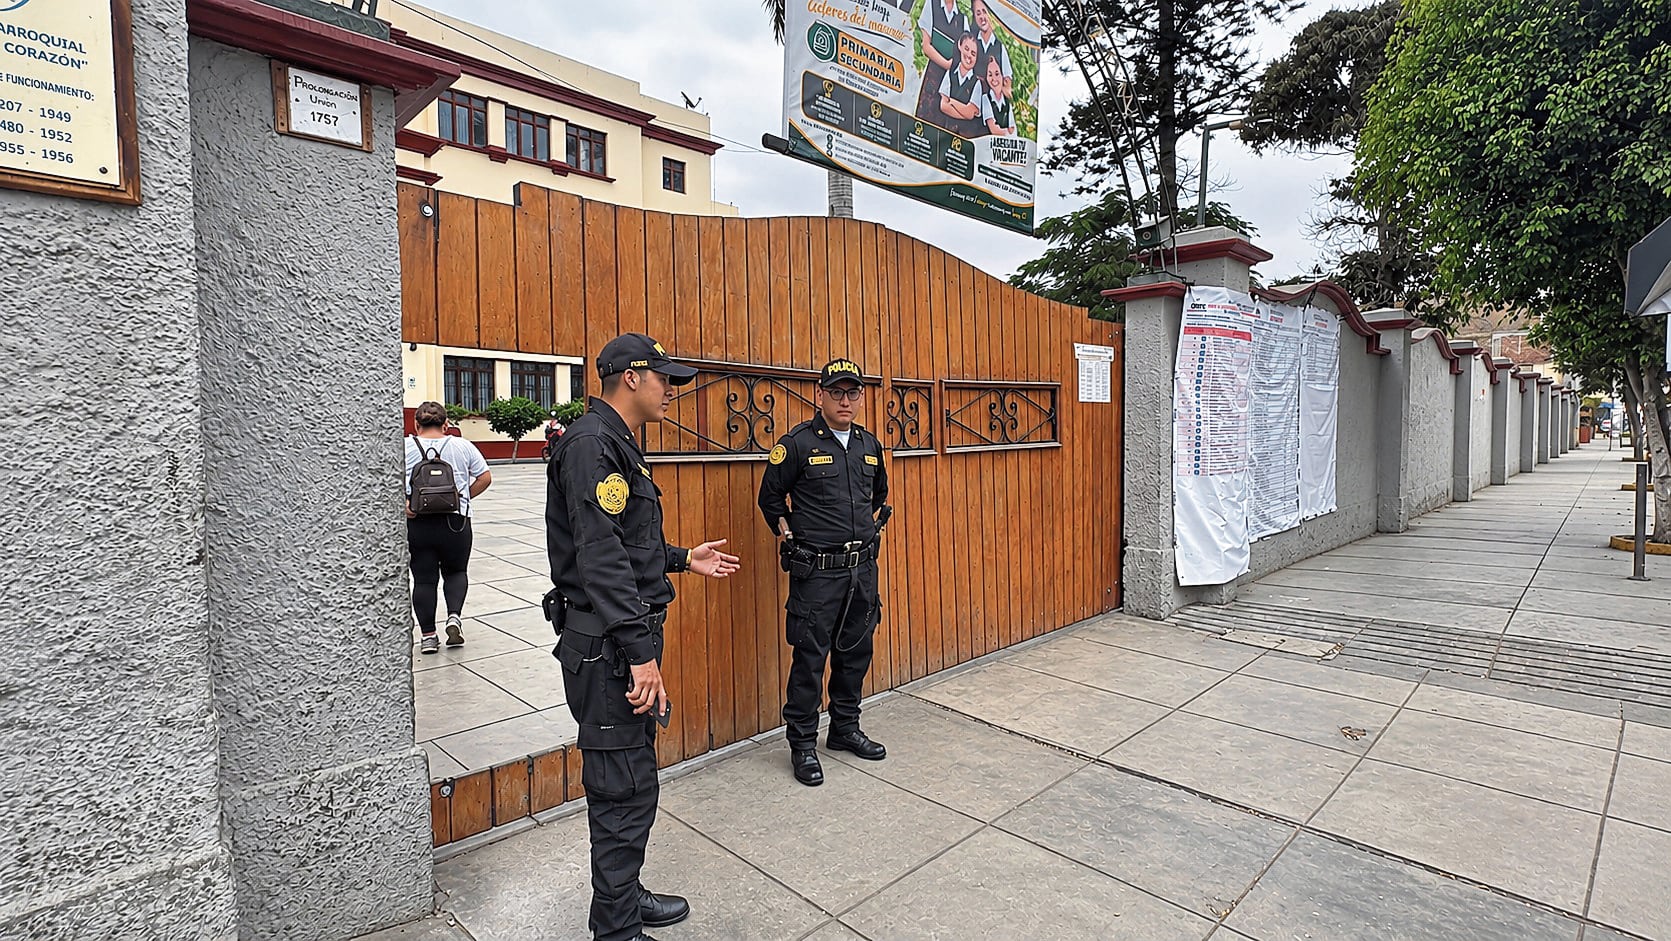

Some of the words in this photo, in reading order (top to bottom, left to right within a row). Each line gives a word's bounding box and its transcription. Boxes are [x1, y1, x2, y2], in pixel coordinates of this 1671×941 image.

[841, 36, 896, 73] PRIMARIA
[840, 53, 901, 88] SECUNDARIA
[6, 73, 95, 101] FUNCIONAMIENTO:
[0, 98, 22, 113] 207
[40, 107, 71, 122] 1949
[310, 110, 339, 127] 1757
[0, 120, 24, 134] 480
[40, 128, 73, 143] 1952
[41, 149, 74, 164] 1956
